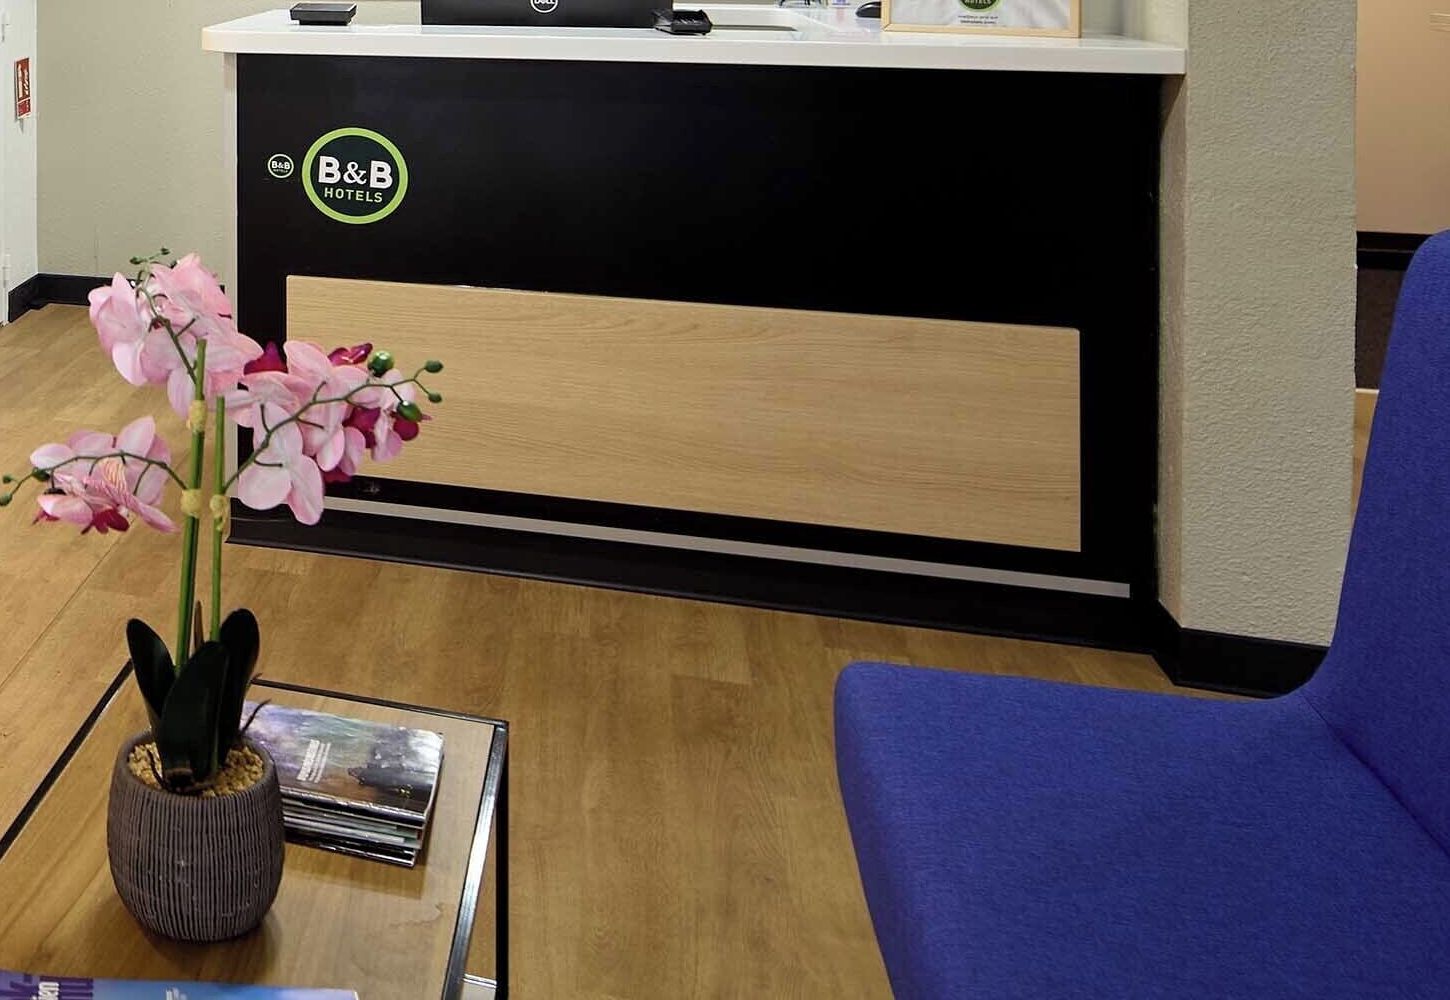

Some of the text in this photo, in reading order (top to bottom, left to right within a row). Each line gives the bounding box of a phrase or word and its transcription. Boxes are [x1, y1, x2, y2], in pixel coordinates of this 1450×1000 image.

[271, 160, 290, 170] B&B
[318, 155, 393, 189] B&B
[324, 187, 383, 203] HOTELS
